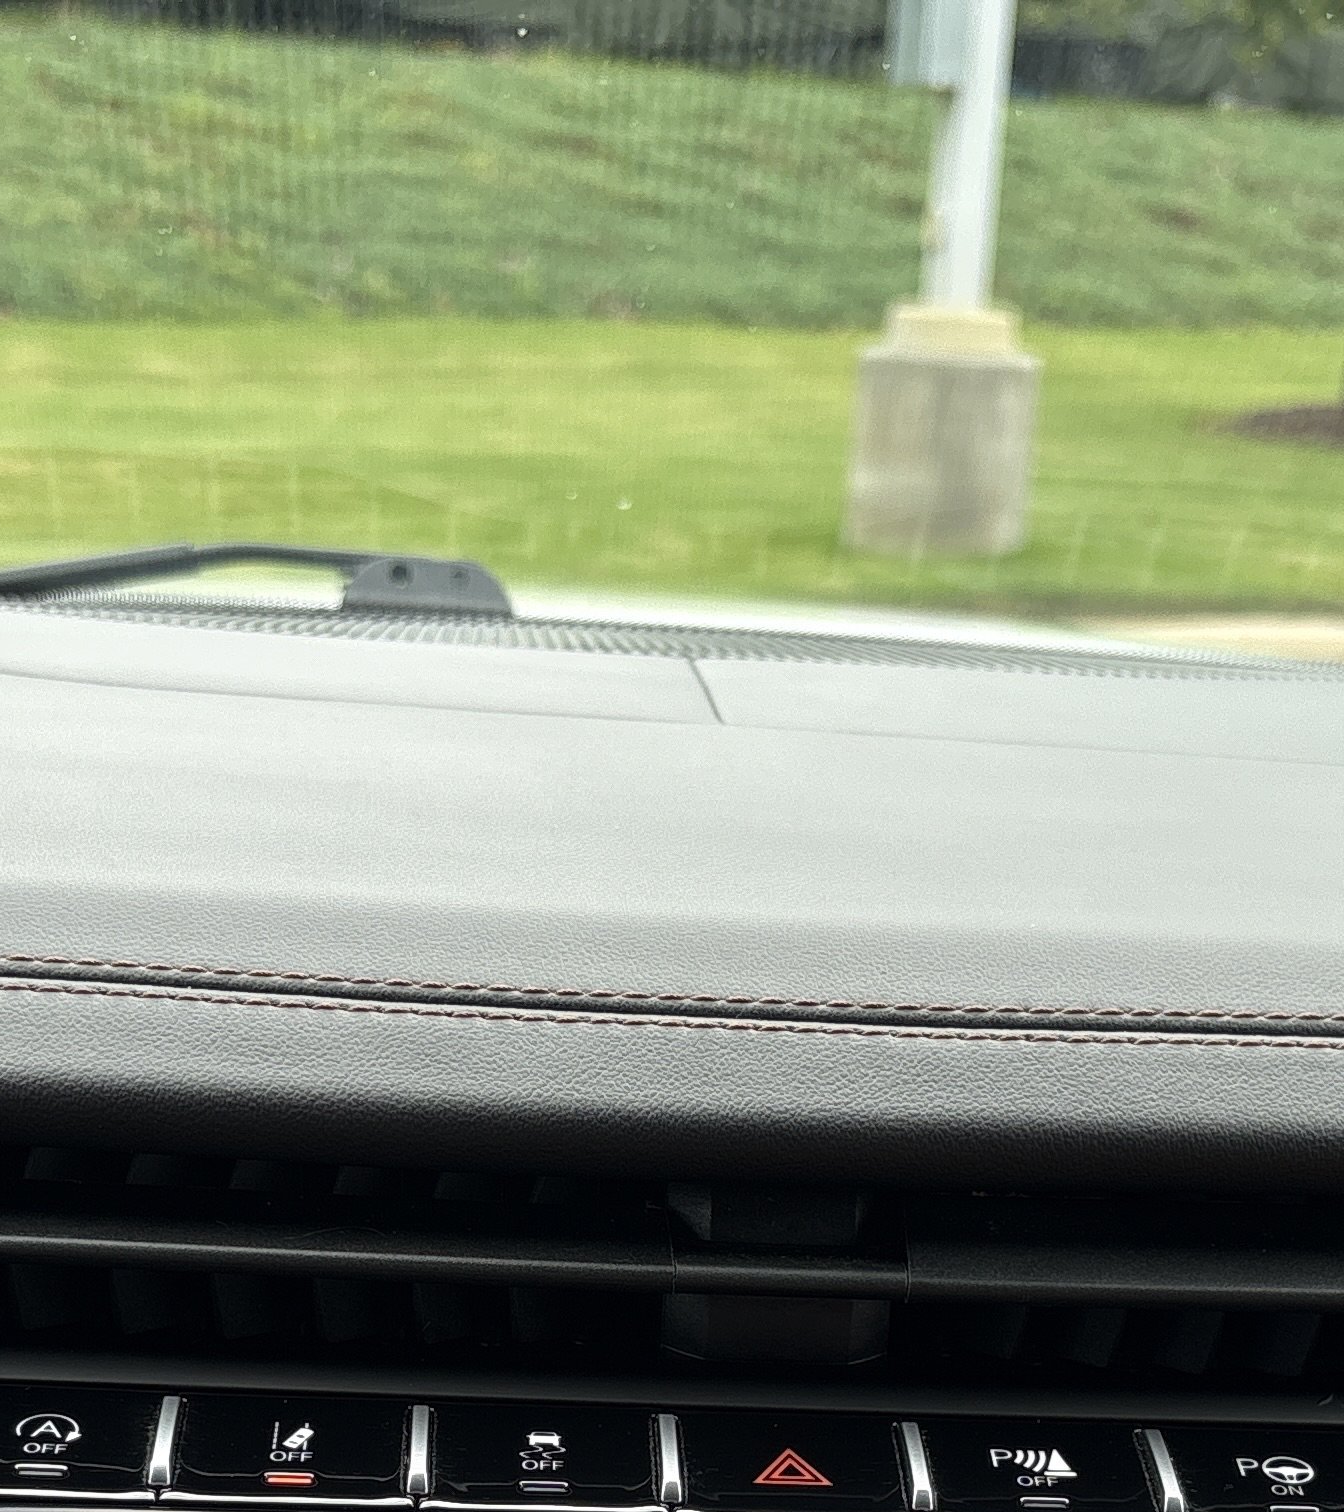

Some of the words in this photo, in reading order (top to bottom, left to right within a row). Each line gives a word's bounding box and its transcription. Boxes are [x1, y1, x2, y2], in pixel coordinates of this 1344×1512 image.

[23, 1442, 68, 1454] OFF
[269, 1450, 313, 1462] OFF
[989, 1449, 1013, 1467] P
[521, 1460, 564, 1470] OFF
[1235, 1458, 1258, 1476] P
[1017, 1475, 1058, 1487] OFF
[1271, 1484, 1305, 1496] ON
